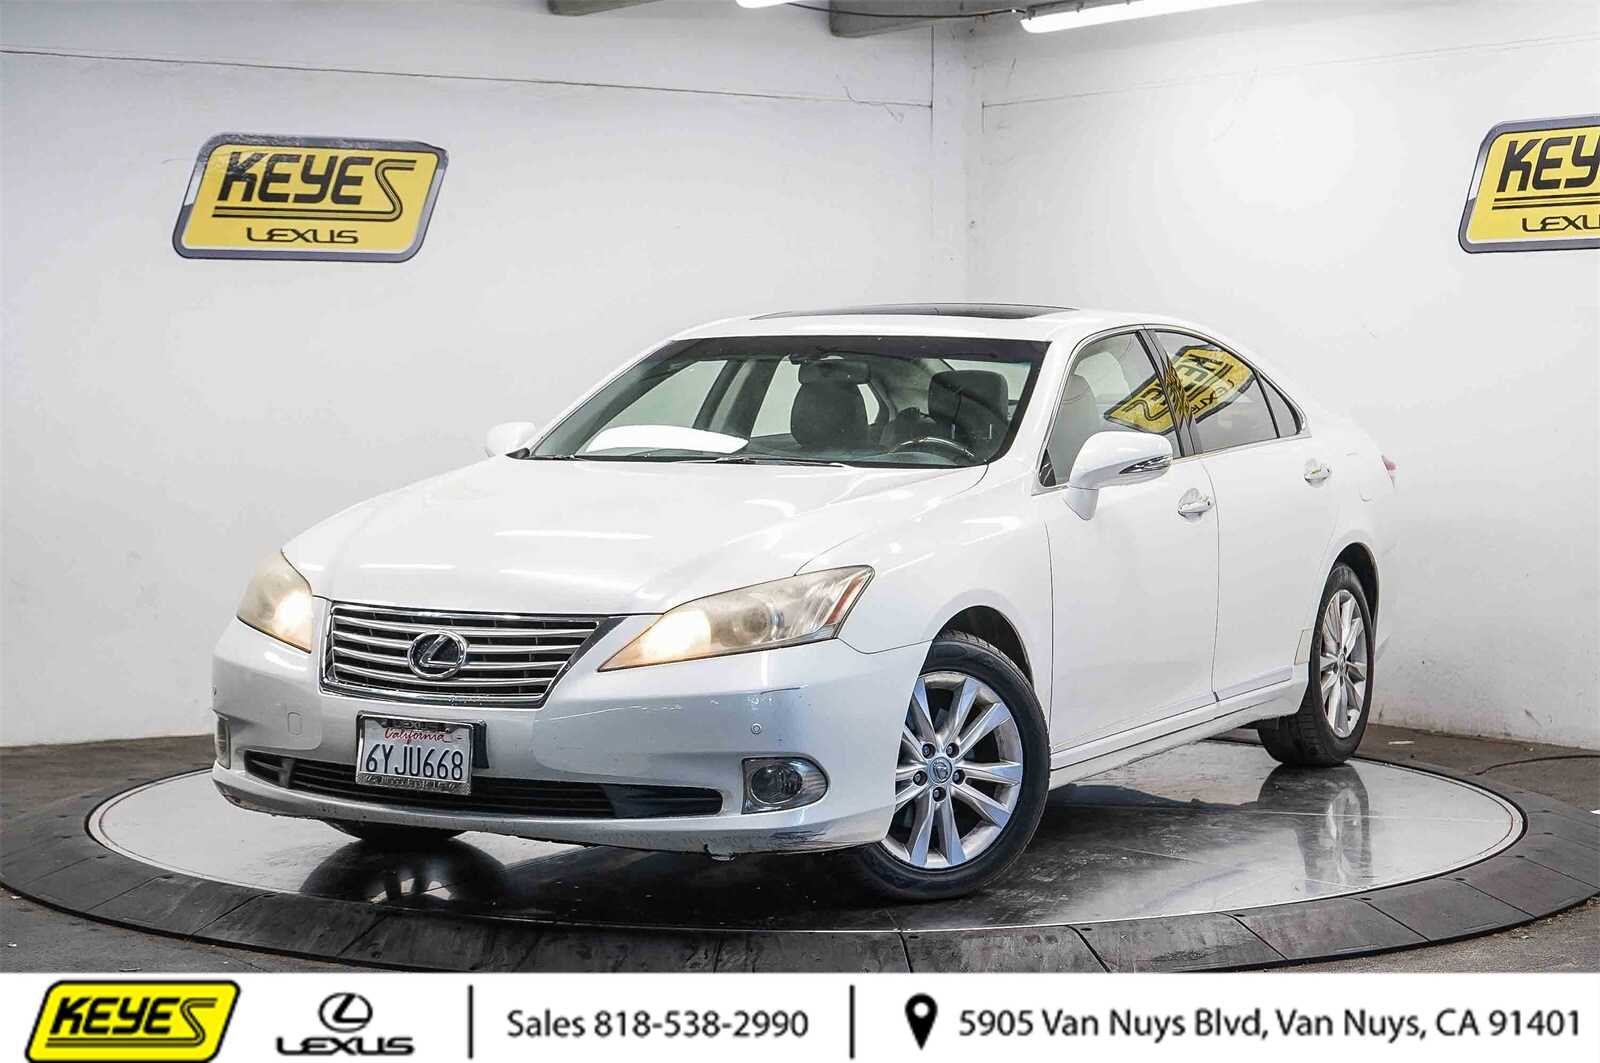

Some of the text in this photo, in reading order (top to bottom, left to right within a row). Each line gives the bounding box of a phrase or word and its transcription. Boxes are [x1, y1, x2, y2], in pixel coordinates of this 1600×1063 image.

[216, 151, 416, 222] KEYES
[246, 227, 359, 244] LEXUS
[384, 727, 448, 745] California
[365, 743, 464, 781] 6YJU668
